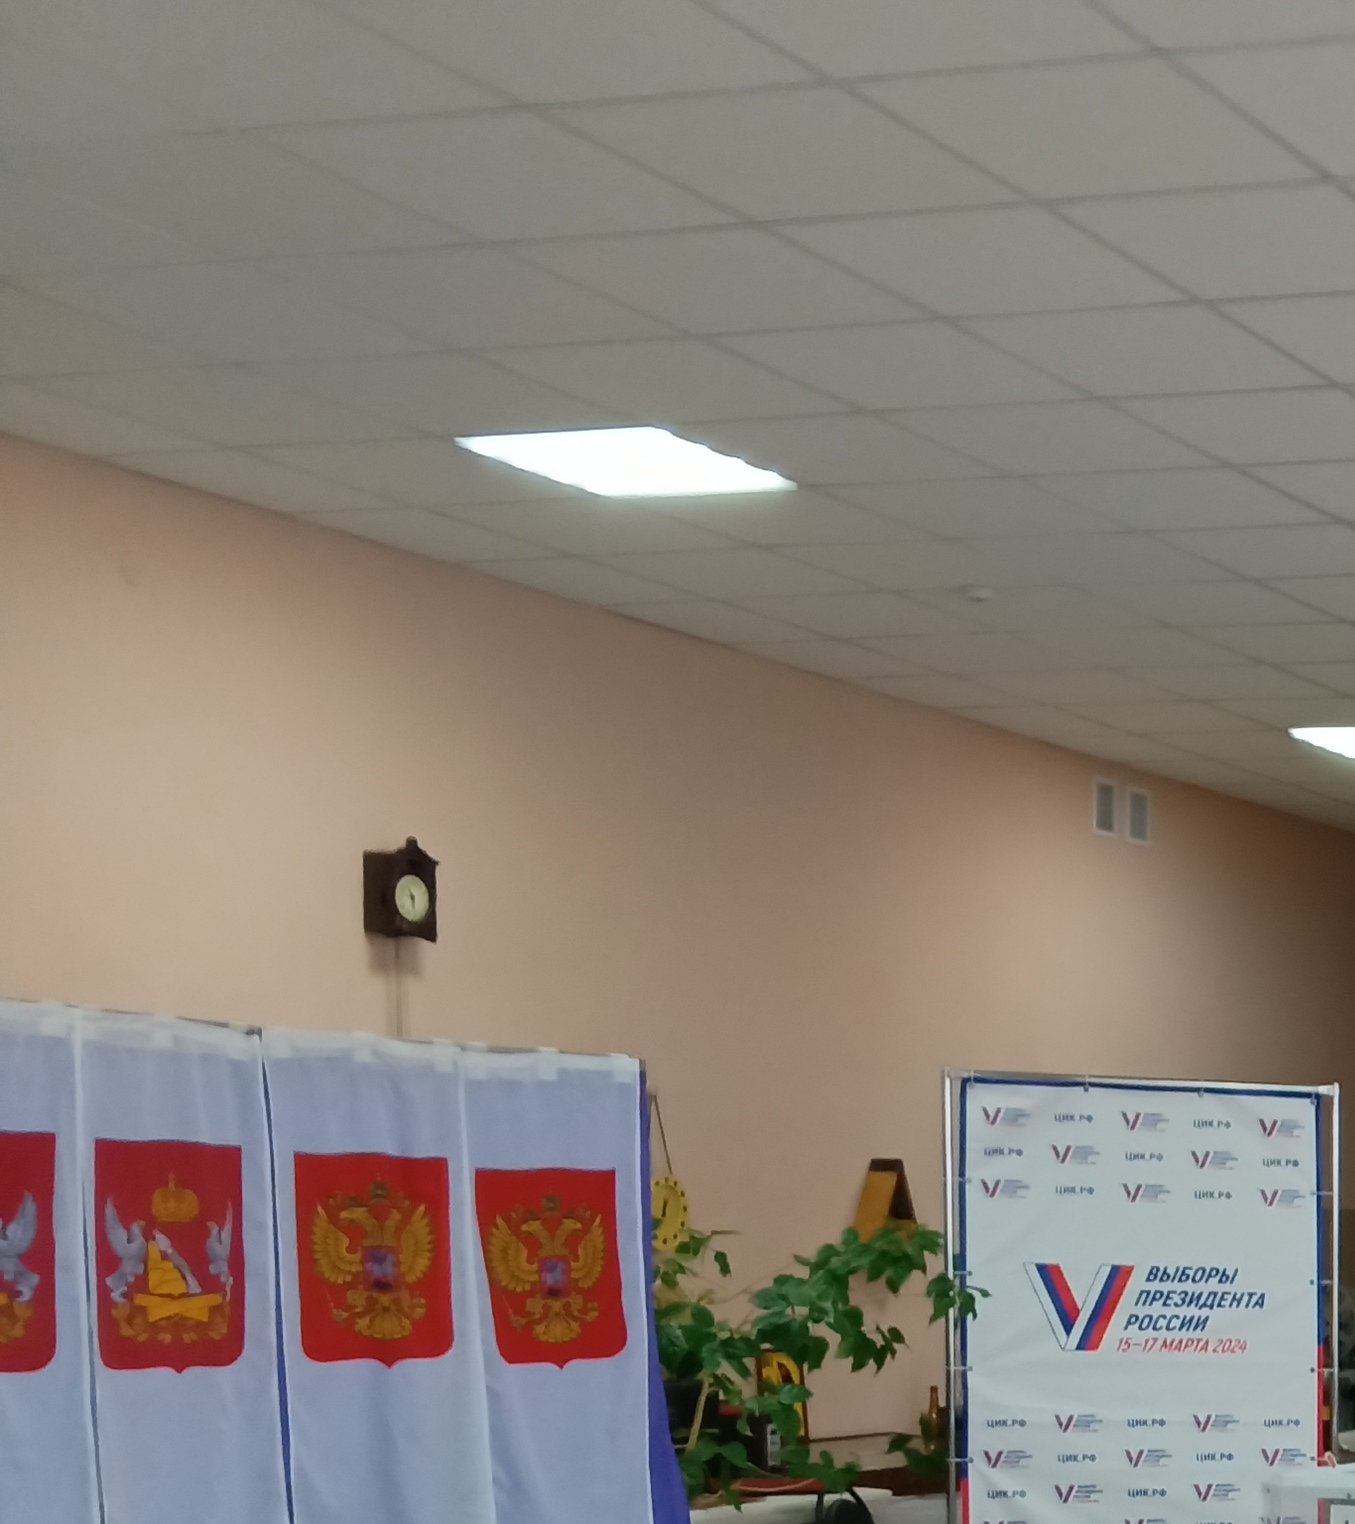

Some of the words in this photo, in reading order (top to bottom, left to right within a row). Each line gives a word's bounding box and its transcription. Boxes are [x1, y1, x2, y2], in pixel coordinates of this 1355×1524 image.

[1145, 1265, 1239, 1285] ВЫБОРЫ
[1134, 1289, 1266, 1310] ПРЕЗИДЕНТА
[1123, 1314, 1210, 1332] РОССИИ
[1159, 1338, 1209, 1354] МАРТА
[1212, 1338, 1248, 1354] 2024
